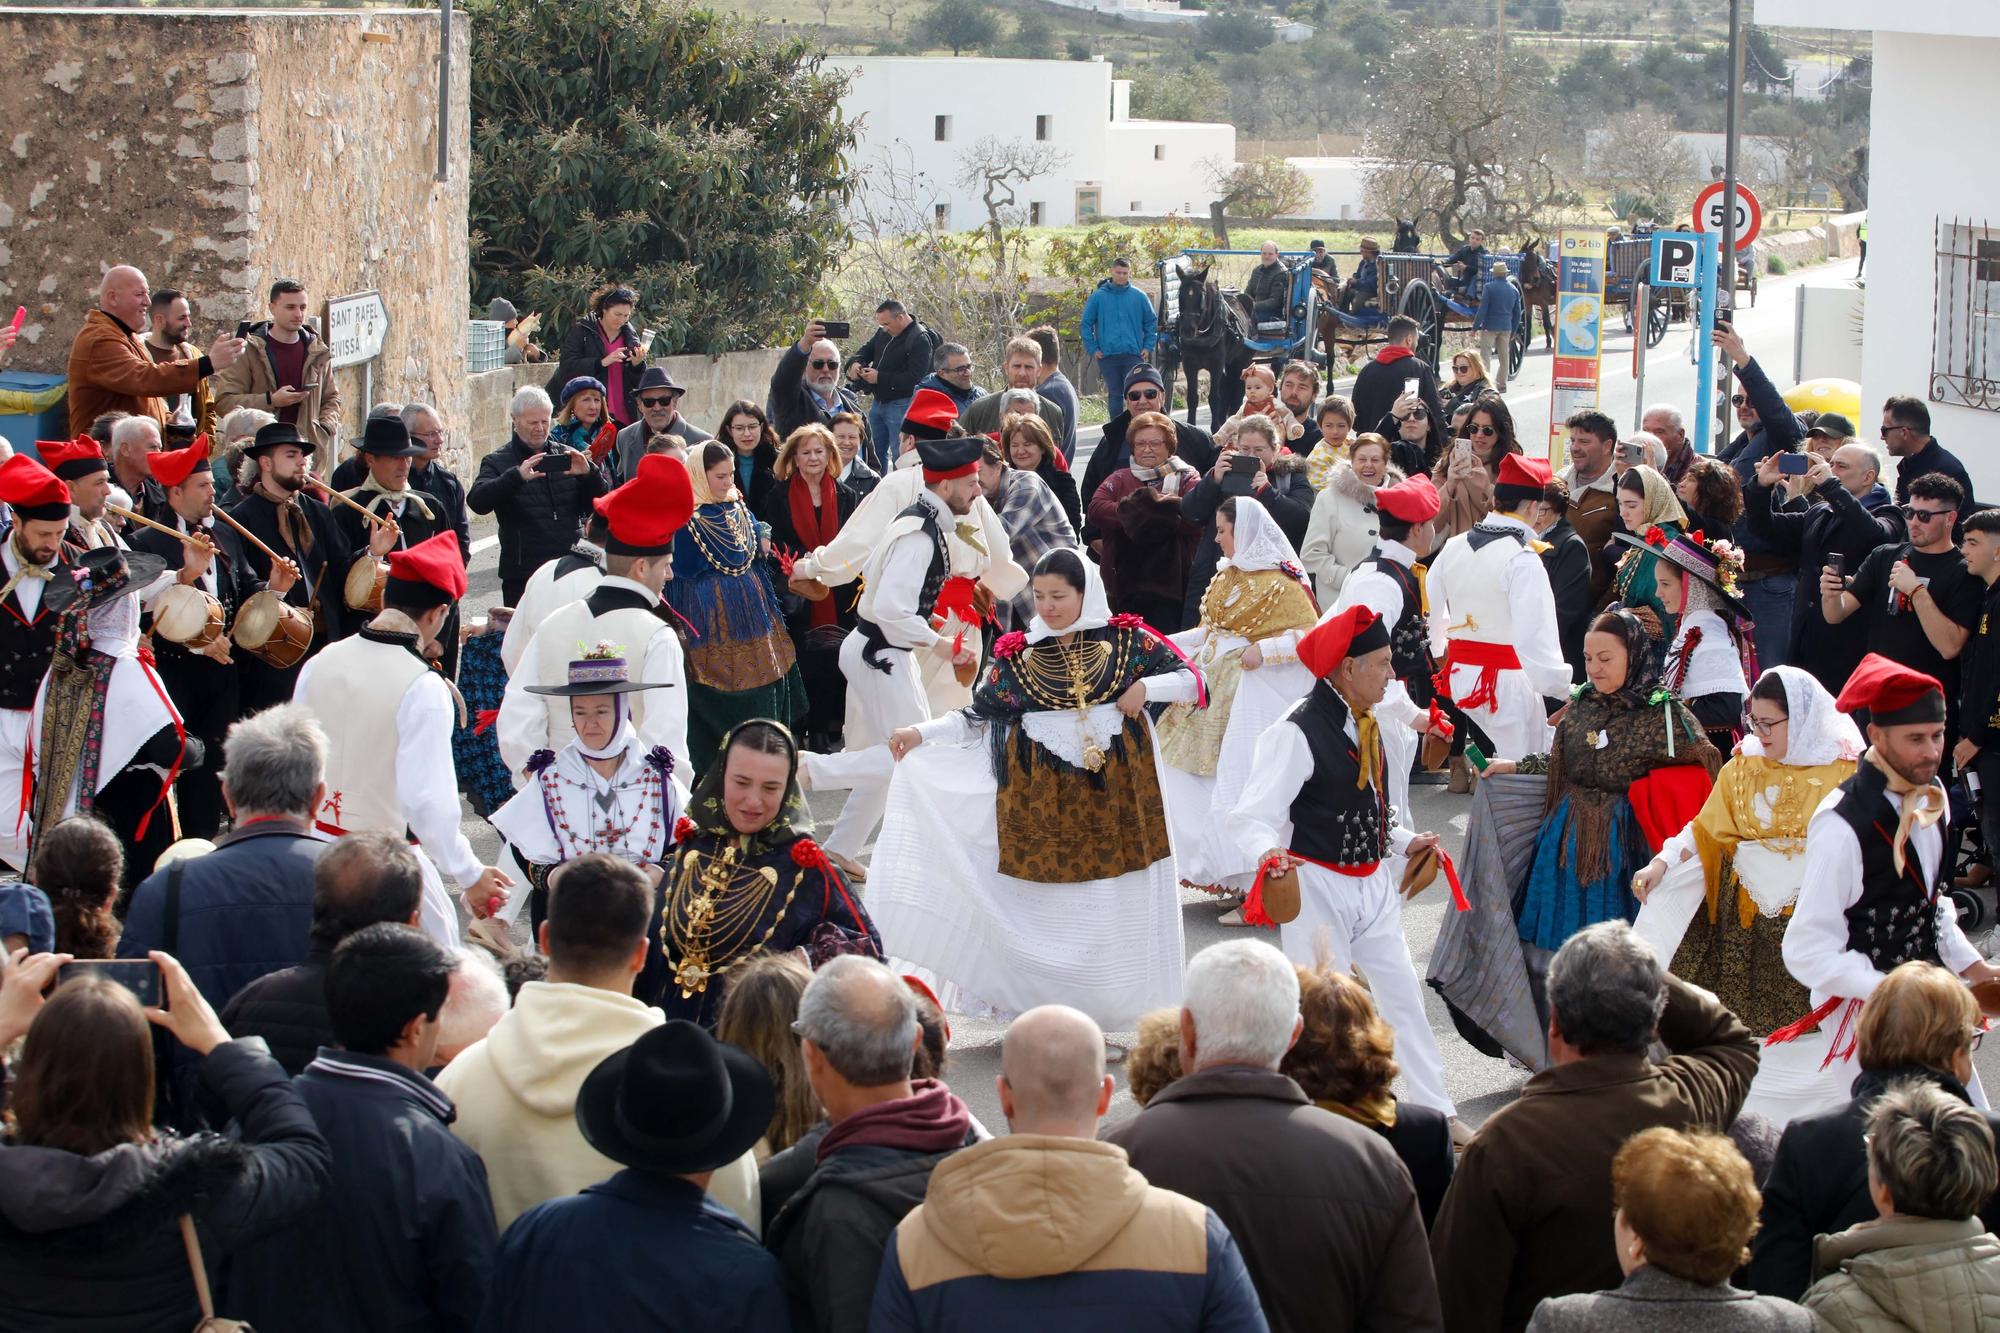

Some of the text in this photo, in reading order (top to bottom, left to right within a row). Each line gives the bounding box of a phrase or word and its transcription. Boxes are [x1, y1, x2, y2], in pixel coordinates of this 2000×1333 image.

[1710, 205, 1746, 228] 50
[1660, 240, 1694, 281] P
[331, 303, 378, 329] SANT RAFEL
[331, 337, 360, 359] EIVISSA
